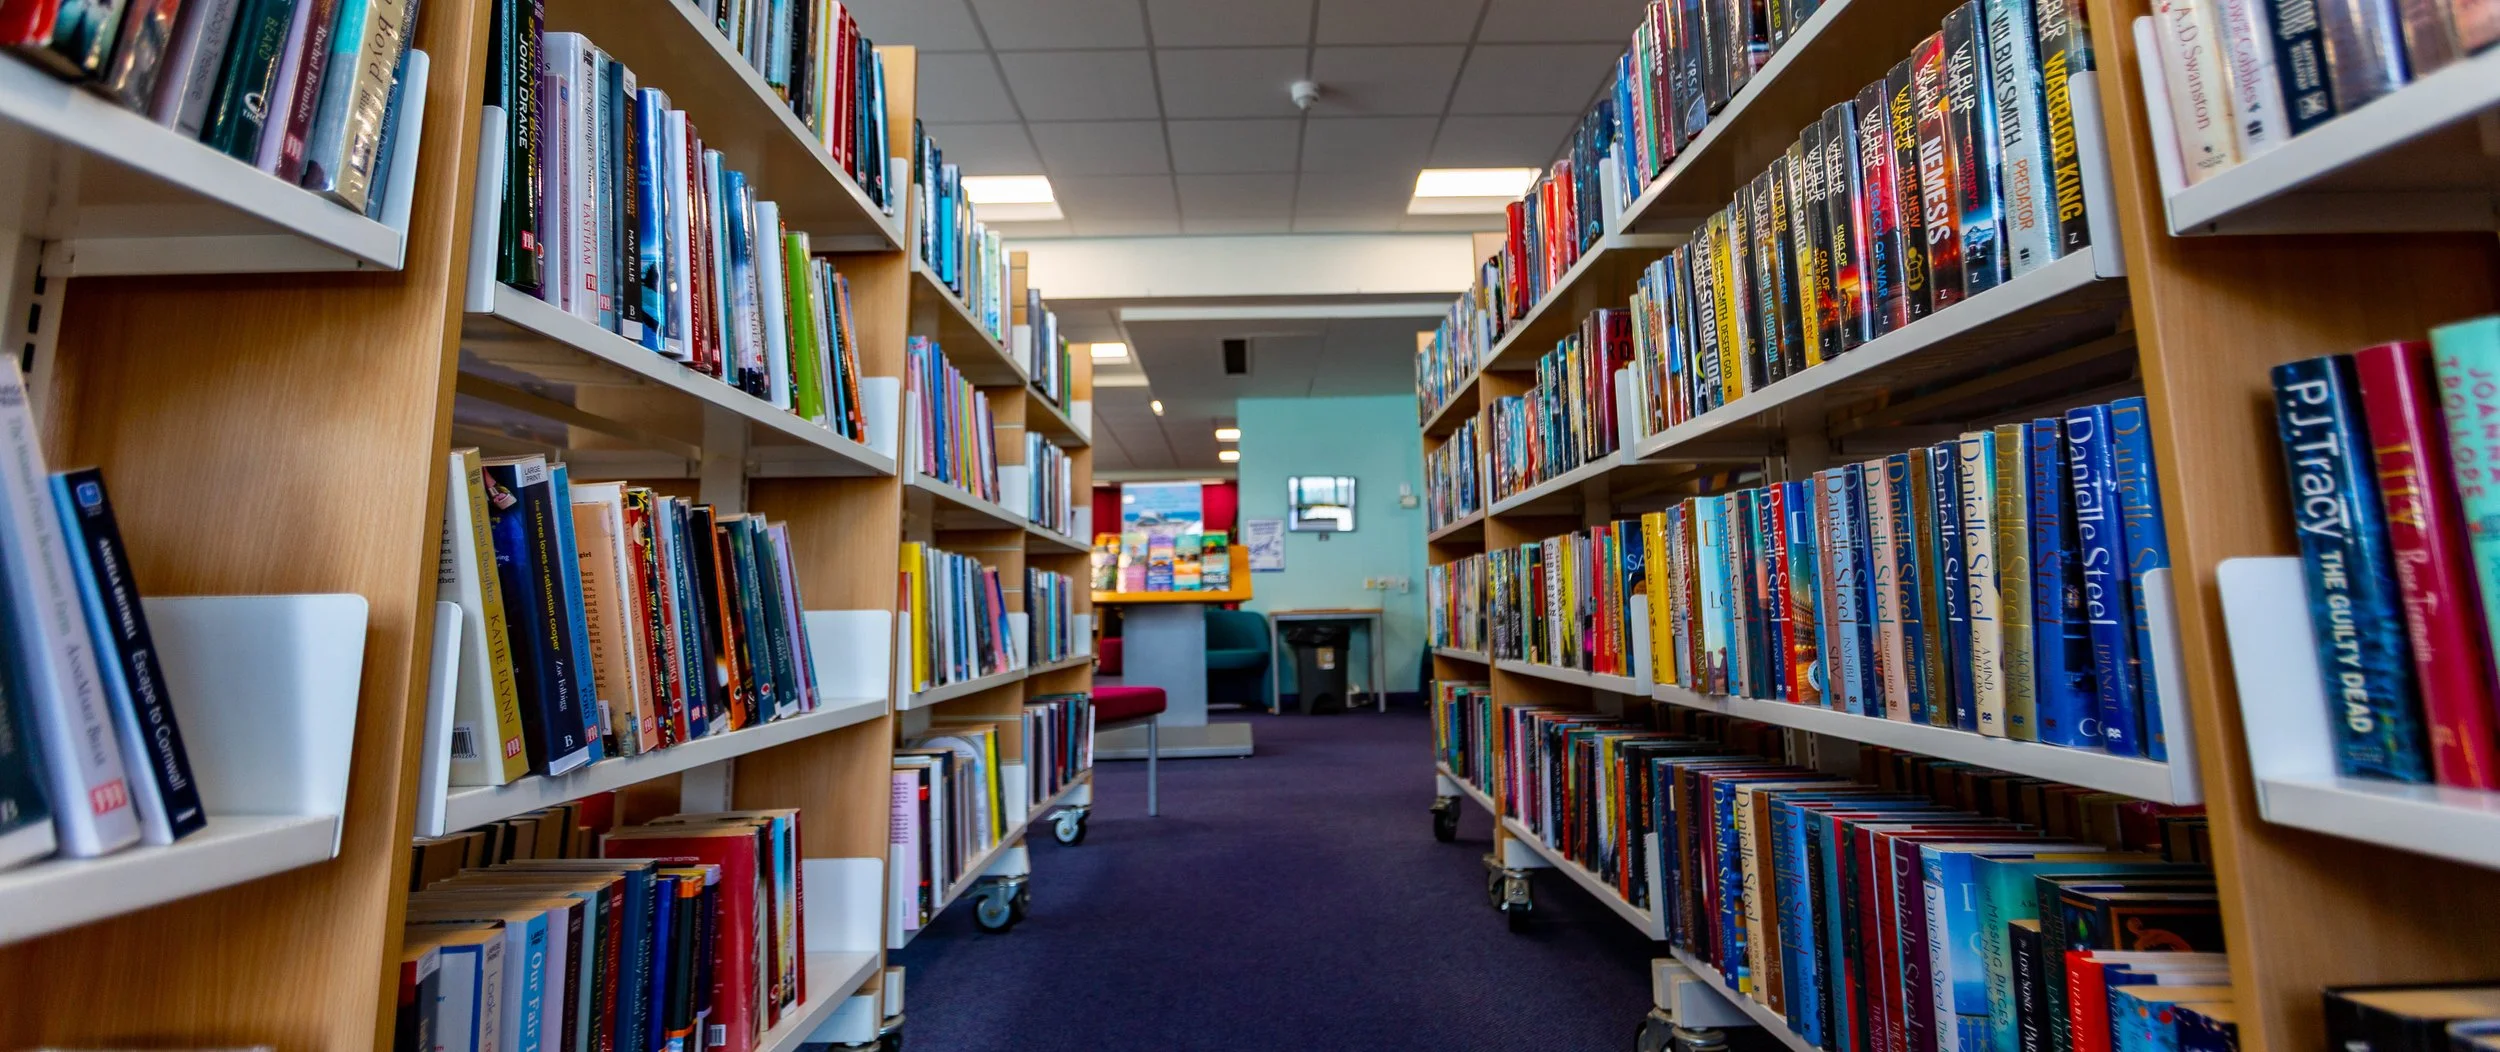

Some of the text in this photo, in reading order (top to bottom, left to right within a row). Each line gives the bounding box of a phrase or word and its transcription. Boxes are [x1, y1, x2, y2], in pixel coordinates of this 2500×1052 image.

[528, 15, 536, 70] SKULL
[298, 25, 328, 123] Rachel Brimble
[519, 33, 529, 148] JOHN DRAKE
[528, 74, 537, 106] AND
[586, 70, 596, 94] Miss
[1686, 58, 1698, 97] YRSA
[1953, 40, 1976, 115] WILBUR
[1990, 9, 2022, 149] WILBUR SMITH
[2043, 49, 2084, 223] WARRIOR KING
[1905, 165, 1921, 229] THE NEW
[1920, 135, 1950, 246] NEMESIS
[2013, 158, 2035, 232] PREDATOR
[583, 204, 593, 265] EASTHAM
[627, 229, 636, 283] MAY ELLIS
[1788, 155, 1815, 340] WILBUR SMITH WAR CRY
[1836, 223, 1848, 267] KING OF
[1869, 182, 1889, 299] LEGACY OF WAR
[1819, 250, 1830, 291] CALL OF
[1700, 289, 1717, 346] STORM
[1712, 240, 1733, 379] WILBUR SMITH DESERT GOD
[1761, 274, 1779, 363] ON THE HORIZON
[1706, 349, 1720, 387] TIDE
[2440, 356, 2485, 498] TROLLOPE
[523, 465, 541, 475] LARGE
[526, 473, 542, 483] PRINT
[2066, 416, 2104, 541] Danielle
[535, 512, 546, 538] three
[1826, 474, 1848, 564] Danielle
[1935, 449, 1964, 622] Danielle Steel
[1960, 438, 1993, 622] Danielle Steel
[539, 540, 549, 565] loves
[1865, 466, 1896, 695] Danielle Steel Resurrection
[1887, 461, 1920, 693] Danielle Steel FLYING ANGELS
[2320, 550, 2348, 590] THE
[544, 573, 557, 617] sebastian
[1766, 572, 1781, 622] Steel
[1775, 571, 1790, 622] Steel
[1836, 567, 1857, 623] Steel
[2081, 547, 2118, 626] Steel
[548, 618, 560, 652] cooper
[681, 608, 691, 635] JEAN
[2328, 593, 2362, 668] GUILTY
[131, 648, 157, 706] Escape
[490, 614, 506, 666] KATIE
[498, 669, 515, 725] FLYNN
[665, 624, 678, 683] DAWN FRENCH
[684, 637, 697, 697] FULLERTON
[1829, 646, 1842, 680] SPY
[1983, 658, 1995, 691] MIND
[149, 705, 162, 725] to
[581, 687, 592, 720] FORD
[2340, 672, 2374, 733] DEAD
[155, 723, 188, 792] Cornwall
[1736, 790, 1754, 868] Danielle
[1742, 871, 1759, 923] Steel
[1924, 884, 1942, 970] Danielle
[1895, 852, 1924, 1030] Danielle Steel
[1988, 903, 2010, 1026] MISSING PIECES
[526, 951, 543, 1040] Our Fair
[1932, 970, 1948, 1012] Steel
[2019, 951, 2033, 1013] LOST SONG
